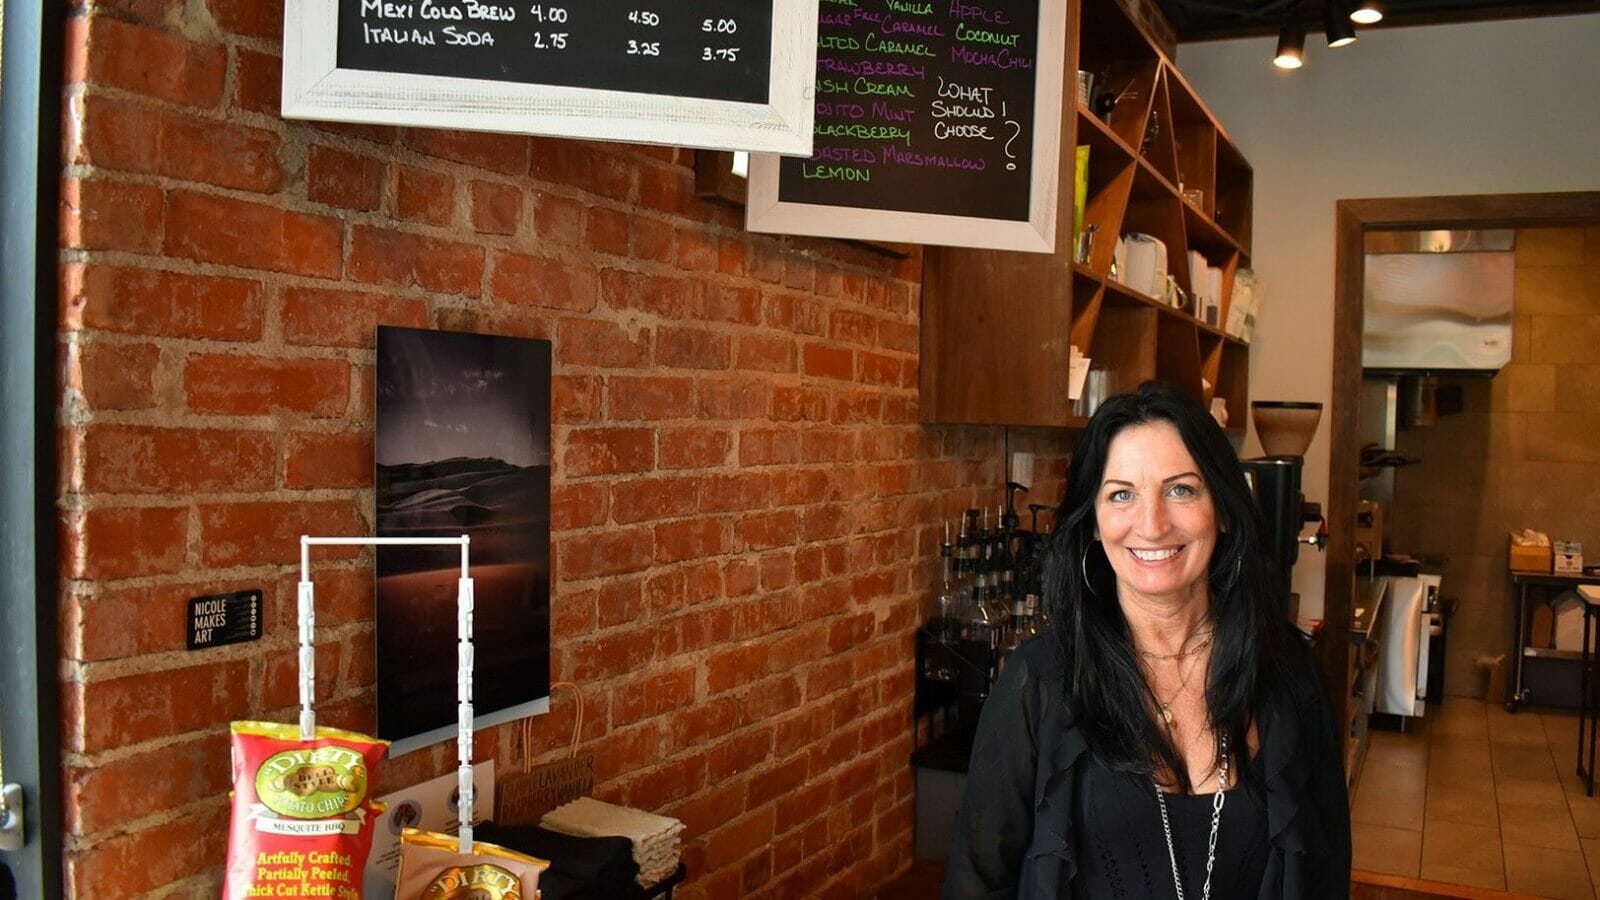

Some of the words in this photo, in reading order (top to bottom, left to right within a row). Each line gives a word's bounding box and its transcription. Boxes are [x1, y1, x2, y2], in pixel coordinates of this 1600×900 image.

[420, 0, 462, 21] COLD
[467, 0, 516, 22] BREW
[530, 4, 568, 24] 4.00
[627, 11, 660, 27] 4.50
[701, 18, 738, 35] 5.00
[885, 0, 934, 15] VANILLA
[949, 0, 1010, 24] APPLE
[363, 22, 436, 46] ITALIAN
[442, 26, 496, 47] SODA
[533, 33, 570, 50] 2.75
[627, 40, 661, 57] 3.25
[701, 45, 740, 63] 3.75
[818, 34, 861, 51] LTED
[864, 32, 936, 57] CARAMEL
[954, 22, 1020, 48] COCONUT
[817, 57, 926, 80] TRAWBERRY
[853, 76, 915, 98] CREAM
[936, 75, 994, 103] WHAT
[816, 102, 865, 121] OJITO
[871, 103, 916, 123] MINT
[931, 100, 995, 119] SHOULD
[934, 121, 995, 140] CHOOSE
[802, 162, 871, 182] LEMON
[194, 598, 227, 617] NICOLE
[194, 612, 227, 631] MAKES
[193, 628, 214, 645] ART
[316, 790, 349, 813] CHIPS
[273, 822, 322, 832] MESQUITE
[324, 822, 346, 833] BBQ
[256, 851, 306, 868] Artfully
[257, 866, 310, 883] Partially
[246, 883, 274, 898] hick
[275, 883, 299, 898] Cut
[300, 882, 335, 898] Kettle
